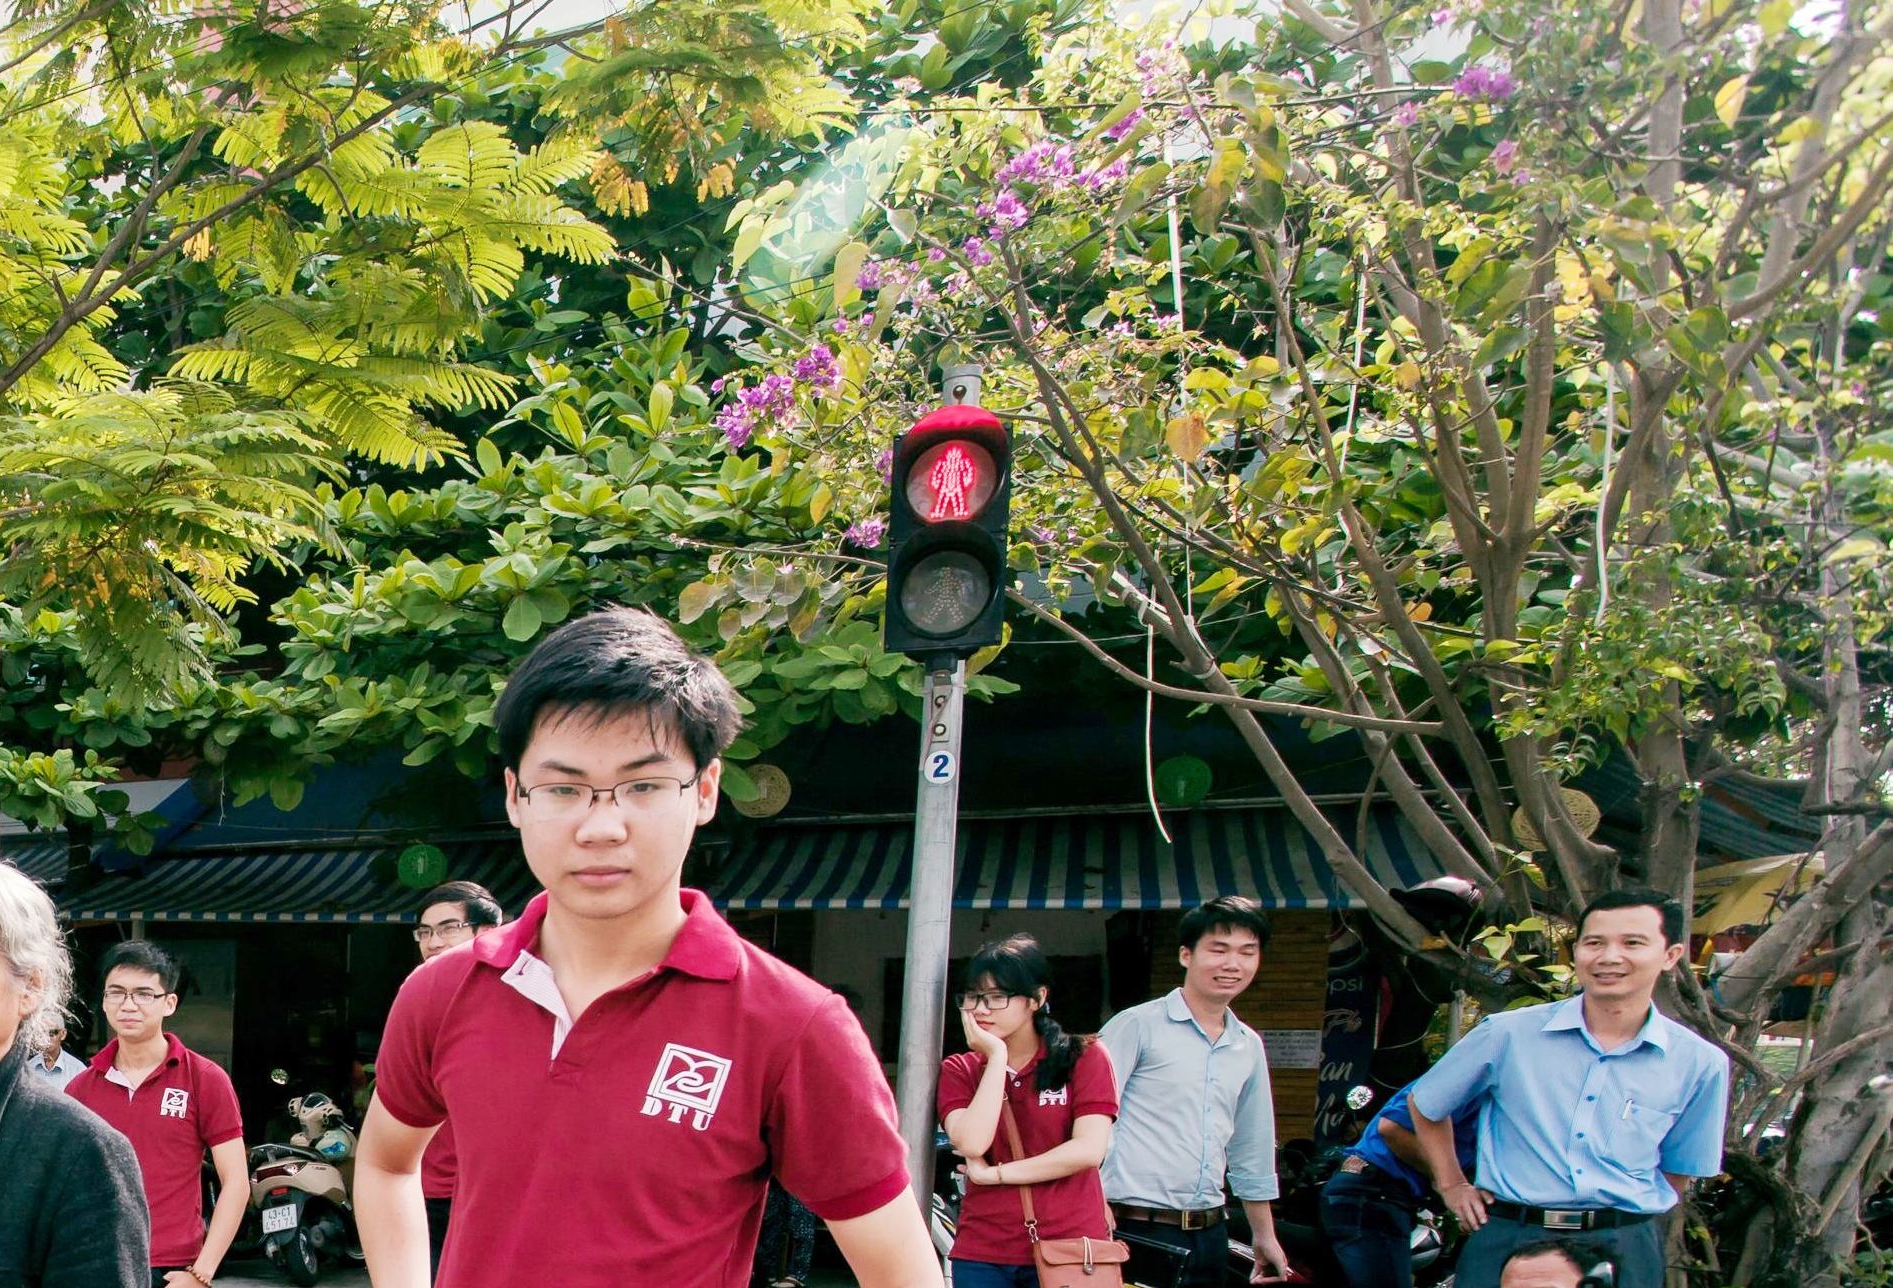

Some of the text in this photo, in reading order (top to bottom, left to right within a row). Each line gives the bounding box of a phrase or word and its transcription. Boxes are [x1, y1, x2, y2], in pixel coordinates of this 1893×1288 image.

[933, 754, 949, 778] 2
[1326, 976, 1363, 995] psi
[1038, 1097, 1067, 1107] DTU
[160, 1106, 186, 1119] DTU
[640, 1095, 714, 1131] DTU
